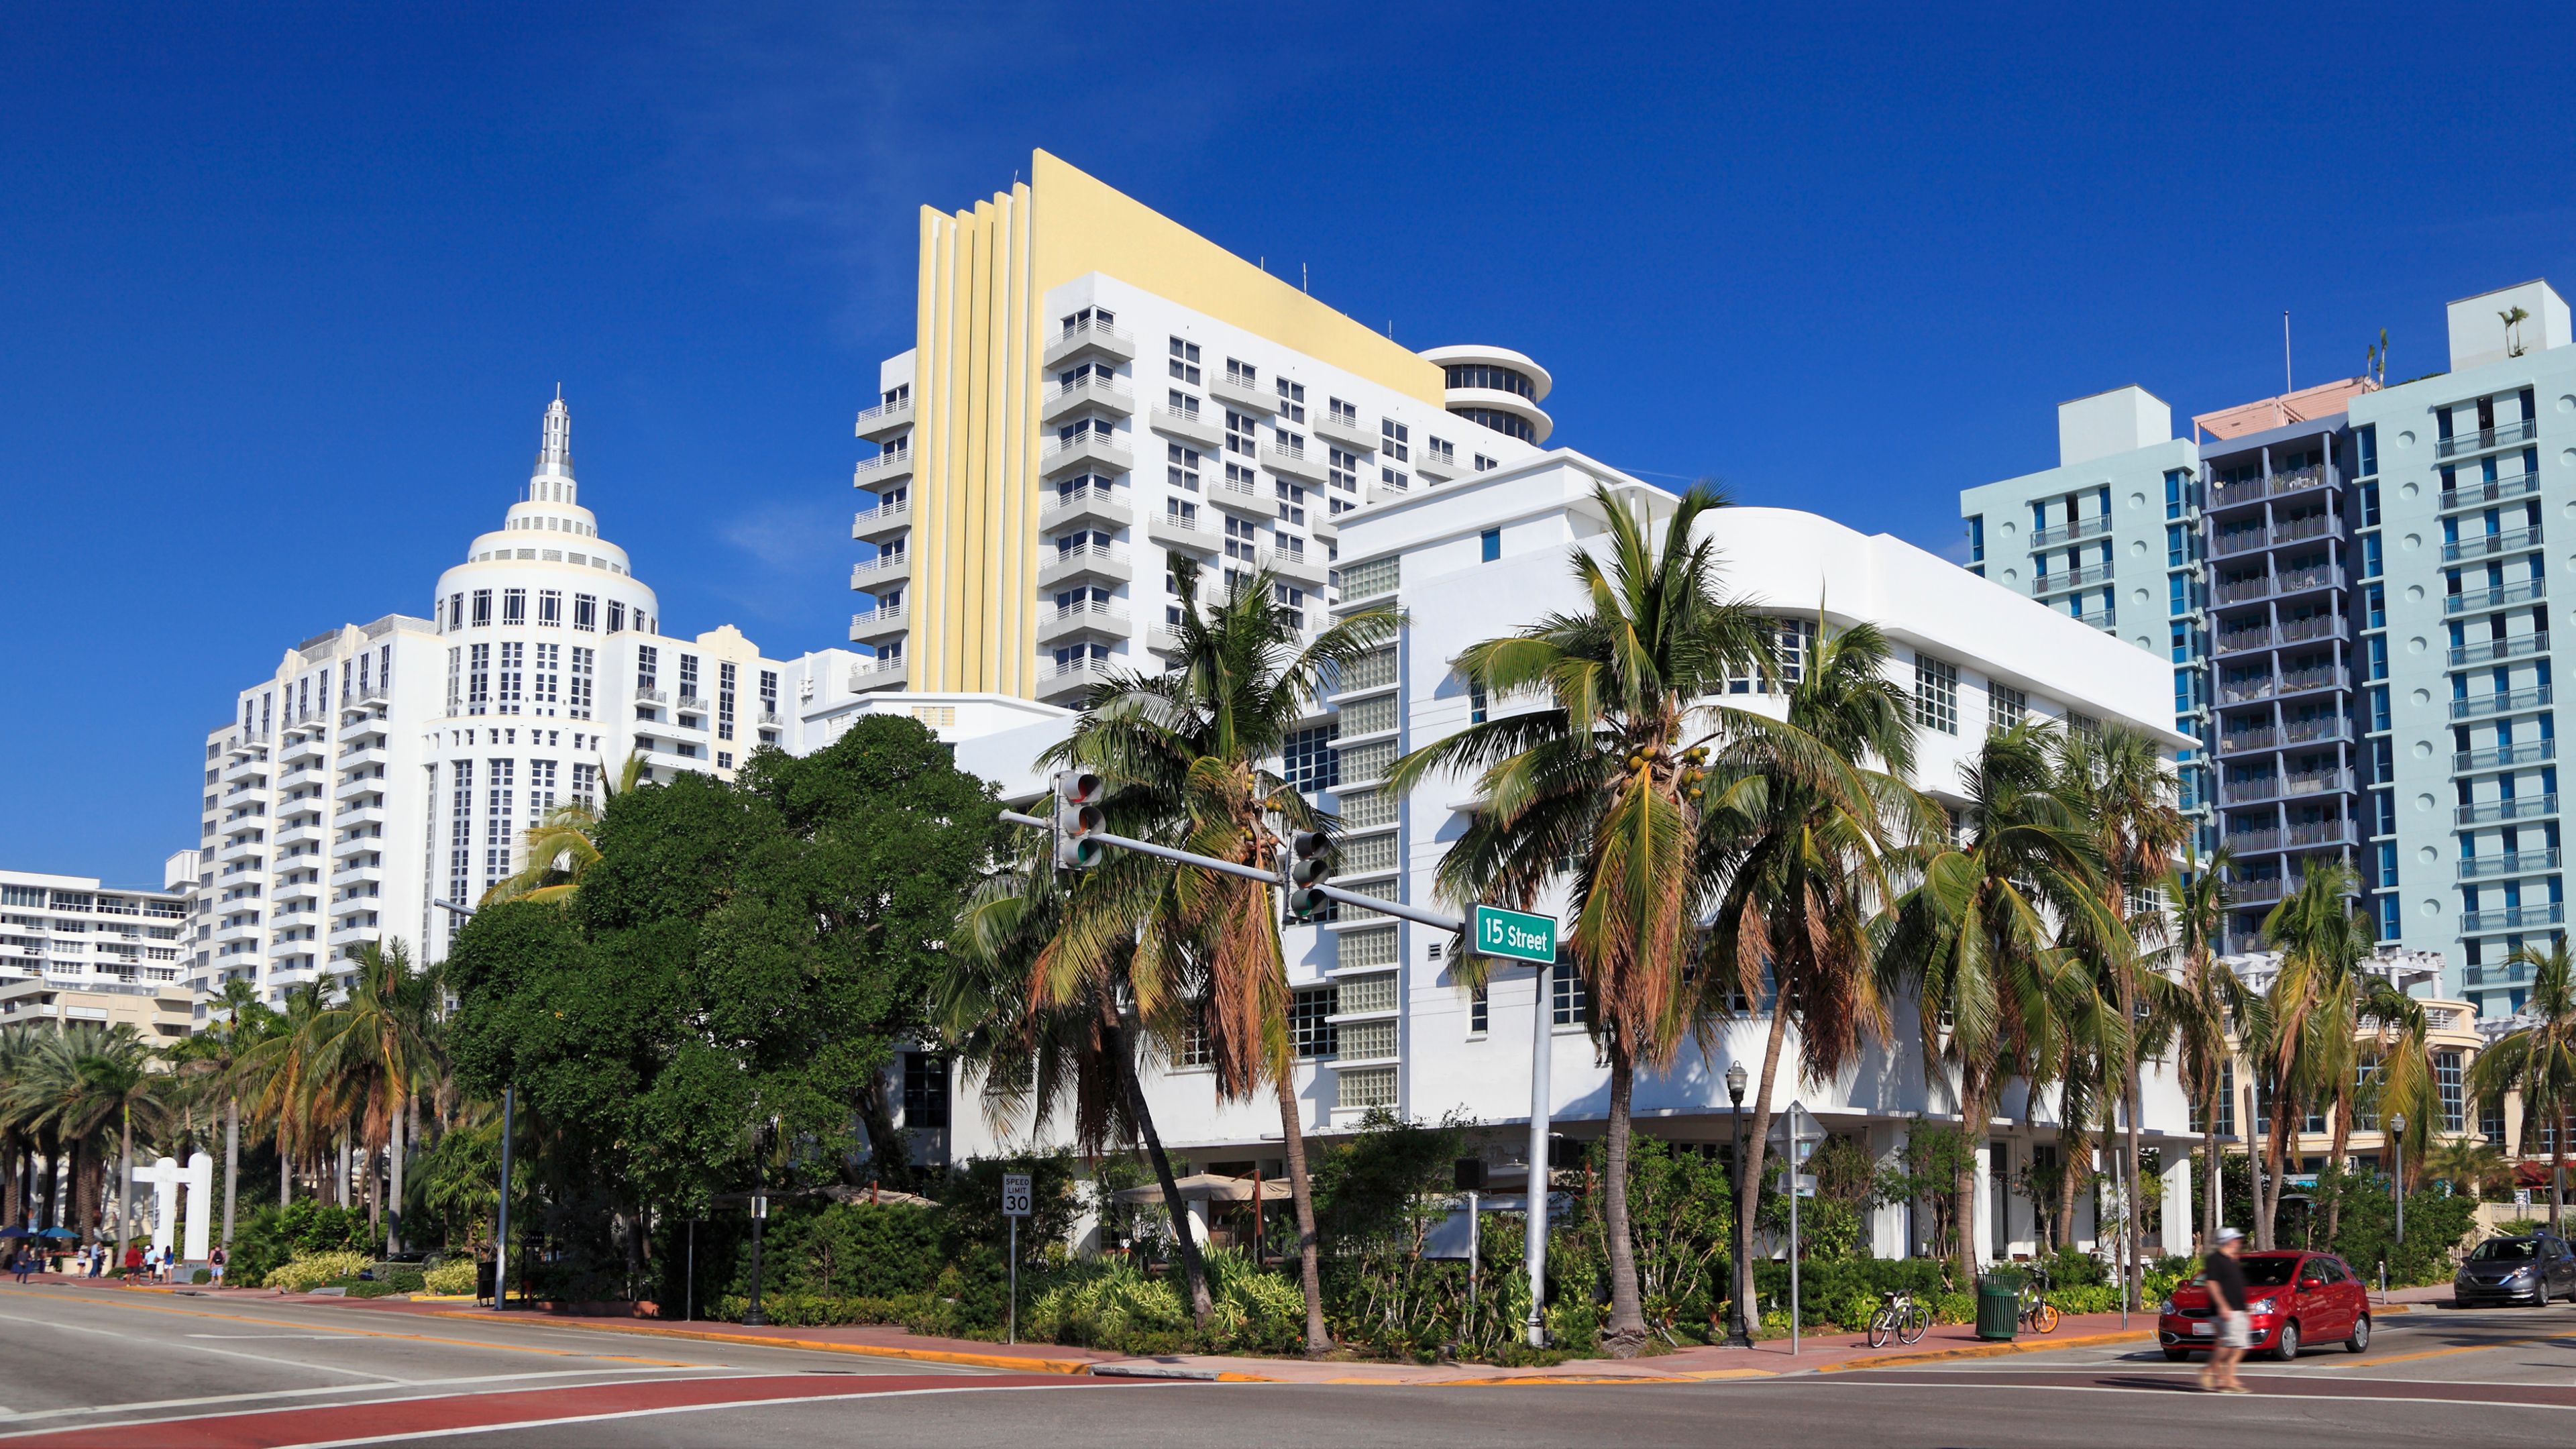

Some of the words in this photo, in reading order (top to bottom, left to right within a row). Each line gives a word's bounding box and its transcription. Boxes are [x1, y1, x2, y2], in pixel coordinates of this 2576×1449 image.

[1486, 918, 1503, 944] 15
[1508, 925, 1547, 952] Street
[1006, 1195, 1028, 1211] 30
